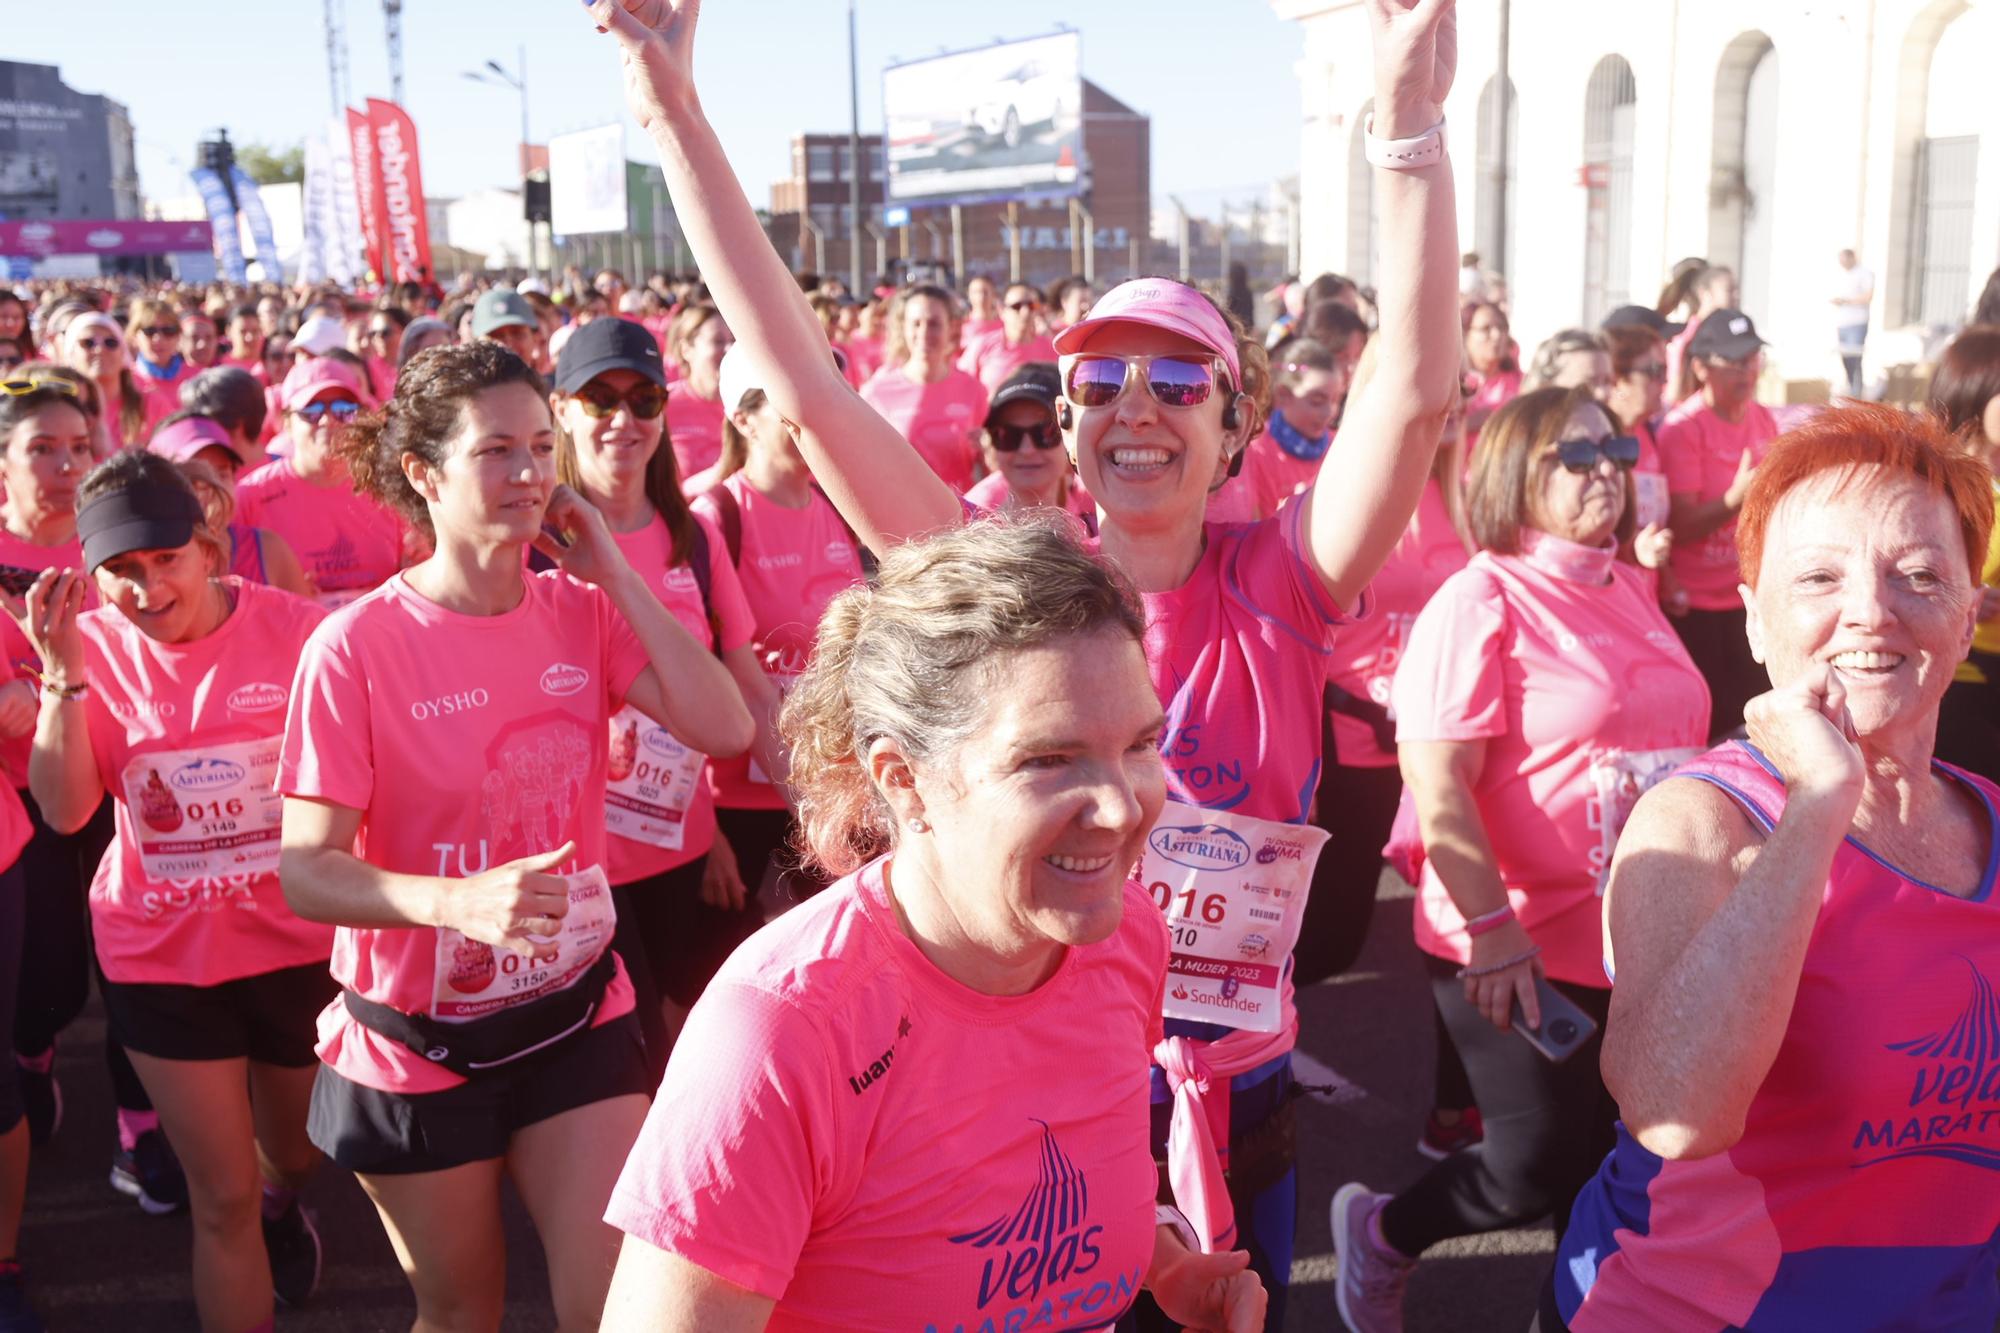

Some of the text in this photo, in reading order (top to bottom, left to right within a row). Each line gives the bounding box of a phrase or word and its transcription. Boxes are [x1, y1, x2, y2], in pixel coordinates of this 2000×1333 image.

[411, 688, 489, 720] OYSHO
[636, 762, 673, 786] 016
[187, 798, 243, 821] 016
[1157, 833, 1240, 863] ASTURIANA
[1149, 881, 1227, 923] 016
[1184, 960, 1228, 975] MUJER
[1230, 967, 1261, 981] 2023
[1190, 989, 1262, 1014] Santander
[1909, 1062, 2000, 1112] vela
[1853, 1108, 2000, 1149] MARAT
[977, 1225, 1103, 1311] velas
